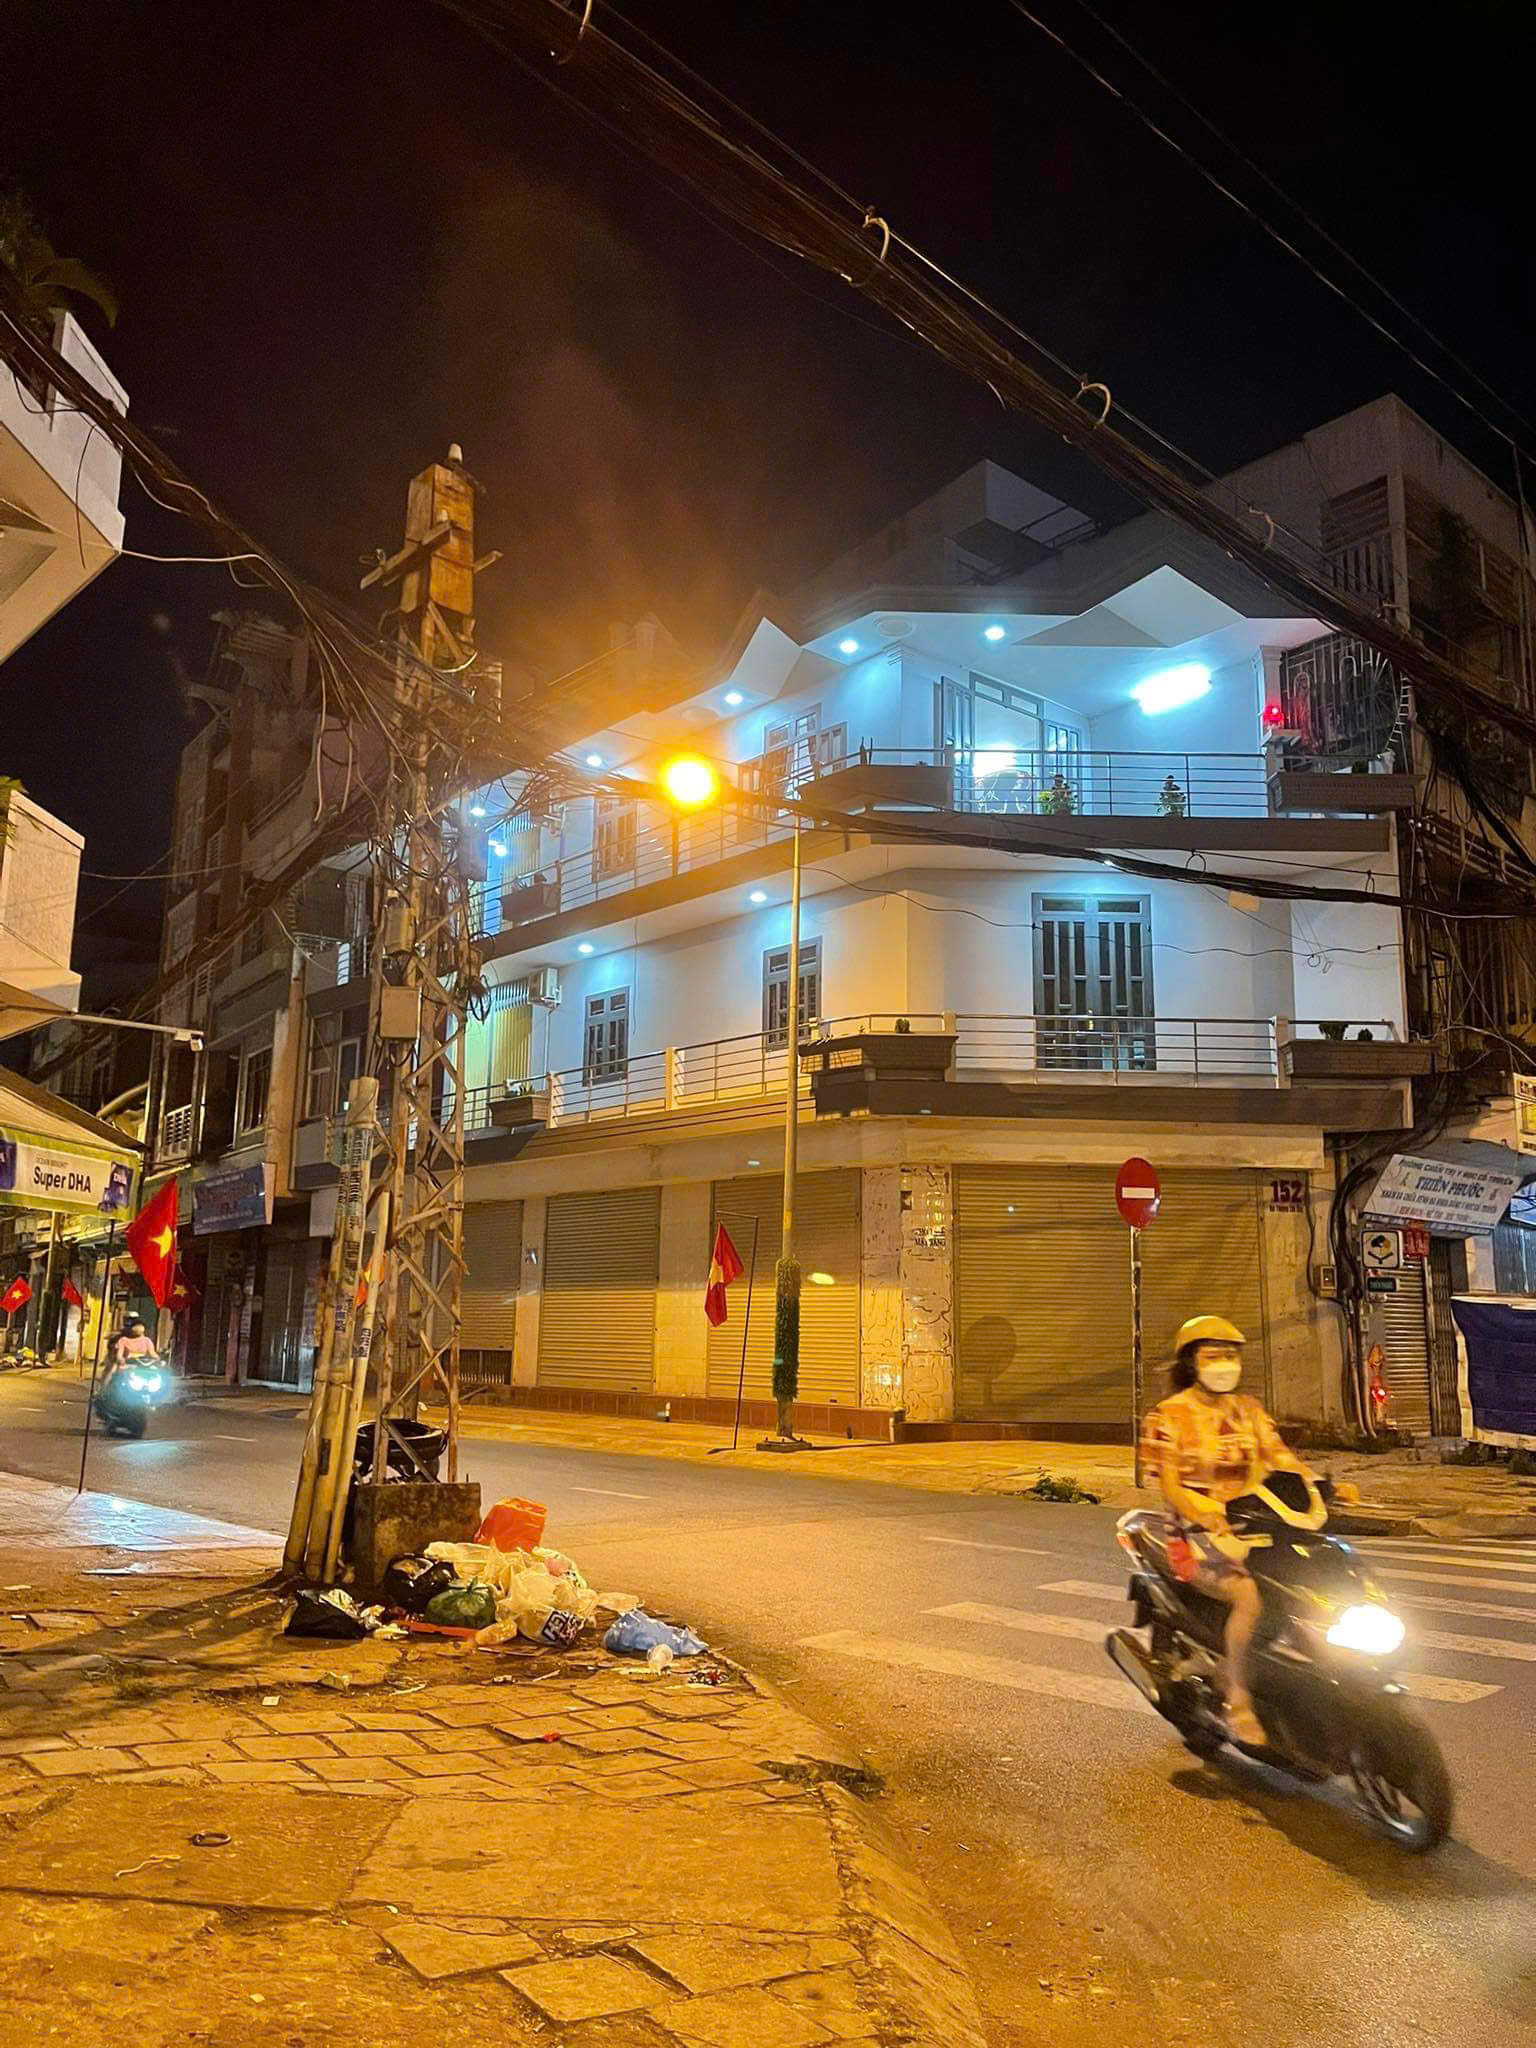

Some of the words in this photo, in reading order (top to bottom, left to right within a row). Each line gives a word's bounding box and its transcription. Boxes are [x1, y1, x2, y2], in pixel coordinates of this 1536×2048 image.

[33, 1165, 66, 1191] Super
[68, 1172, 91, 1193] DHA
[1271, 1180, 1303, 1203] 152
